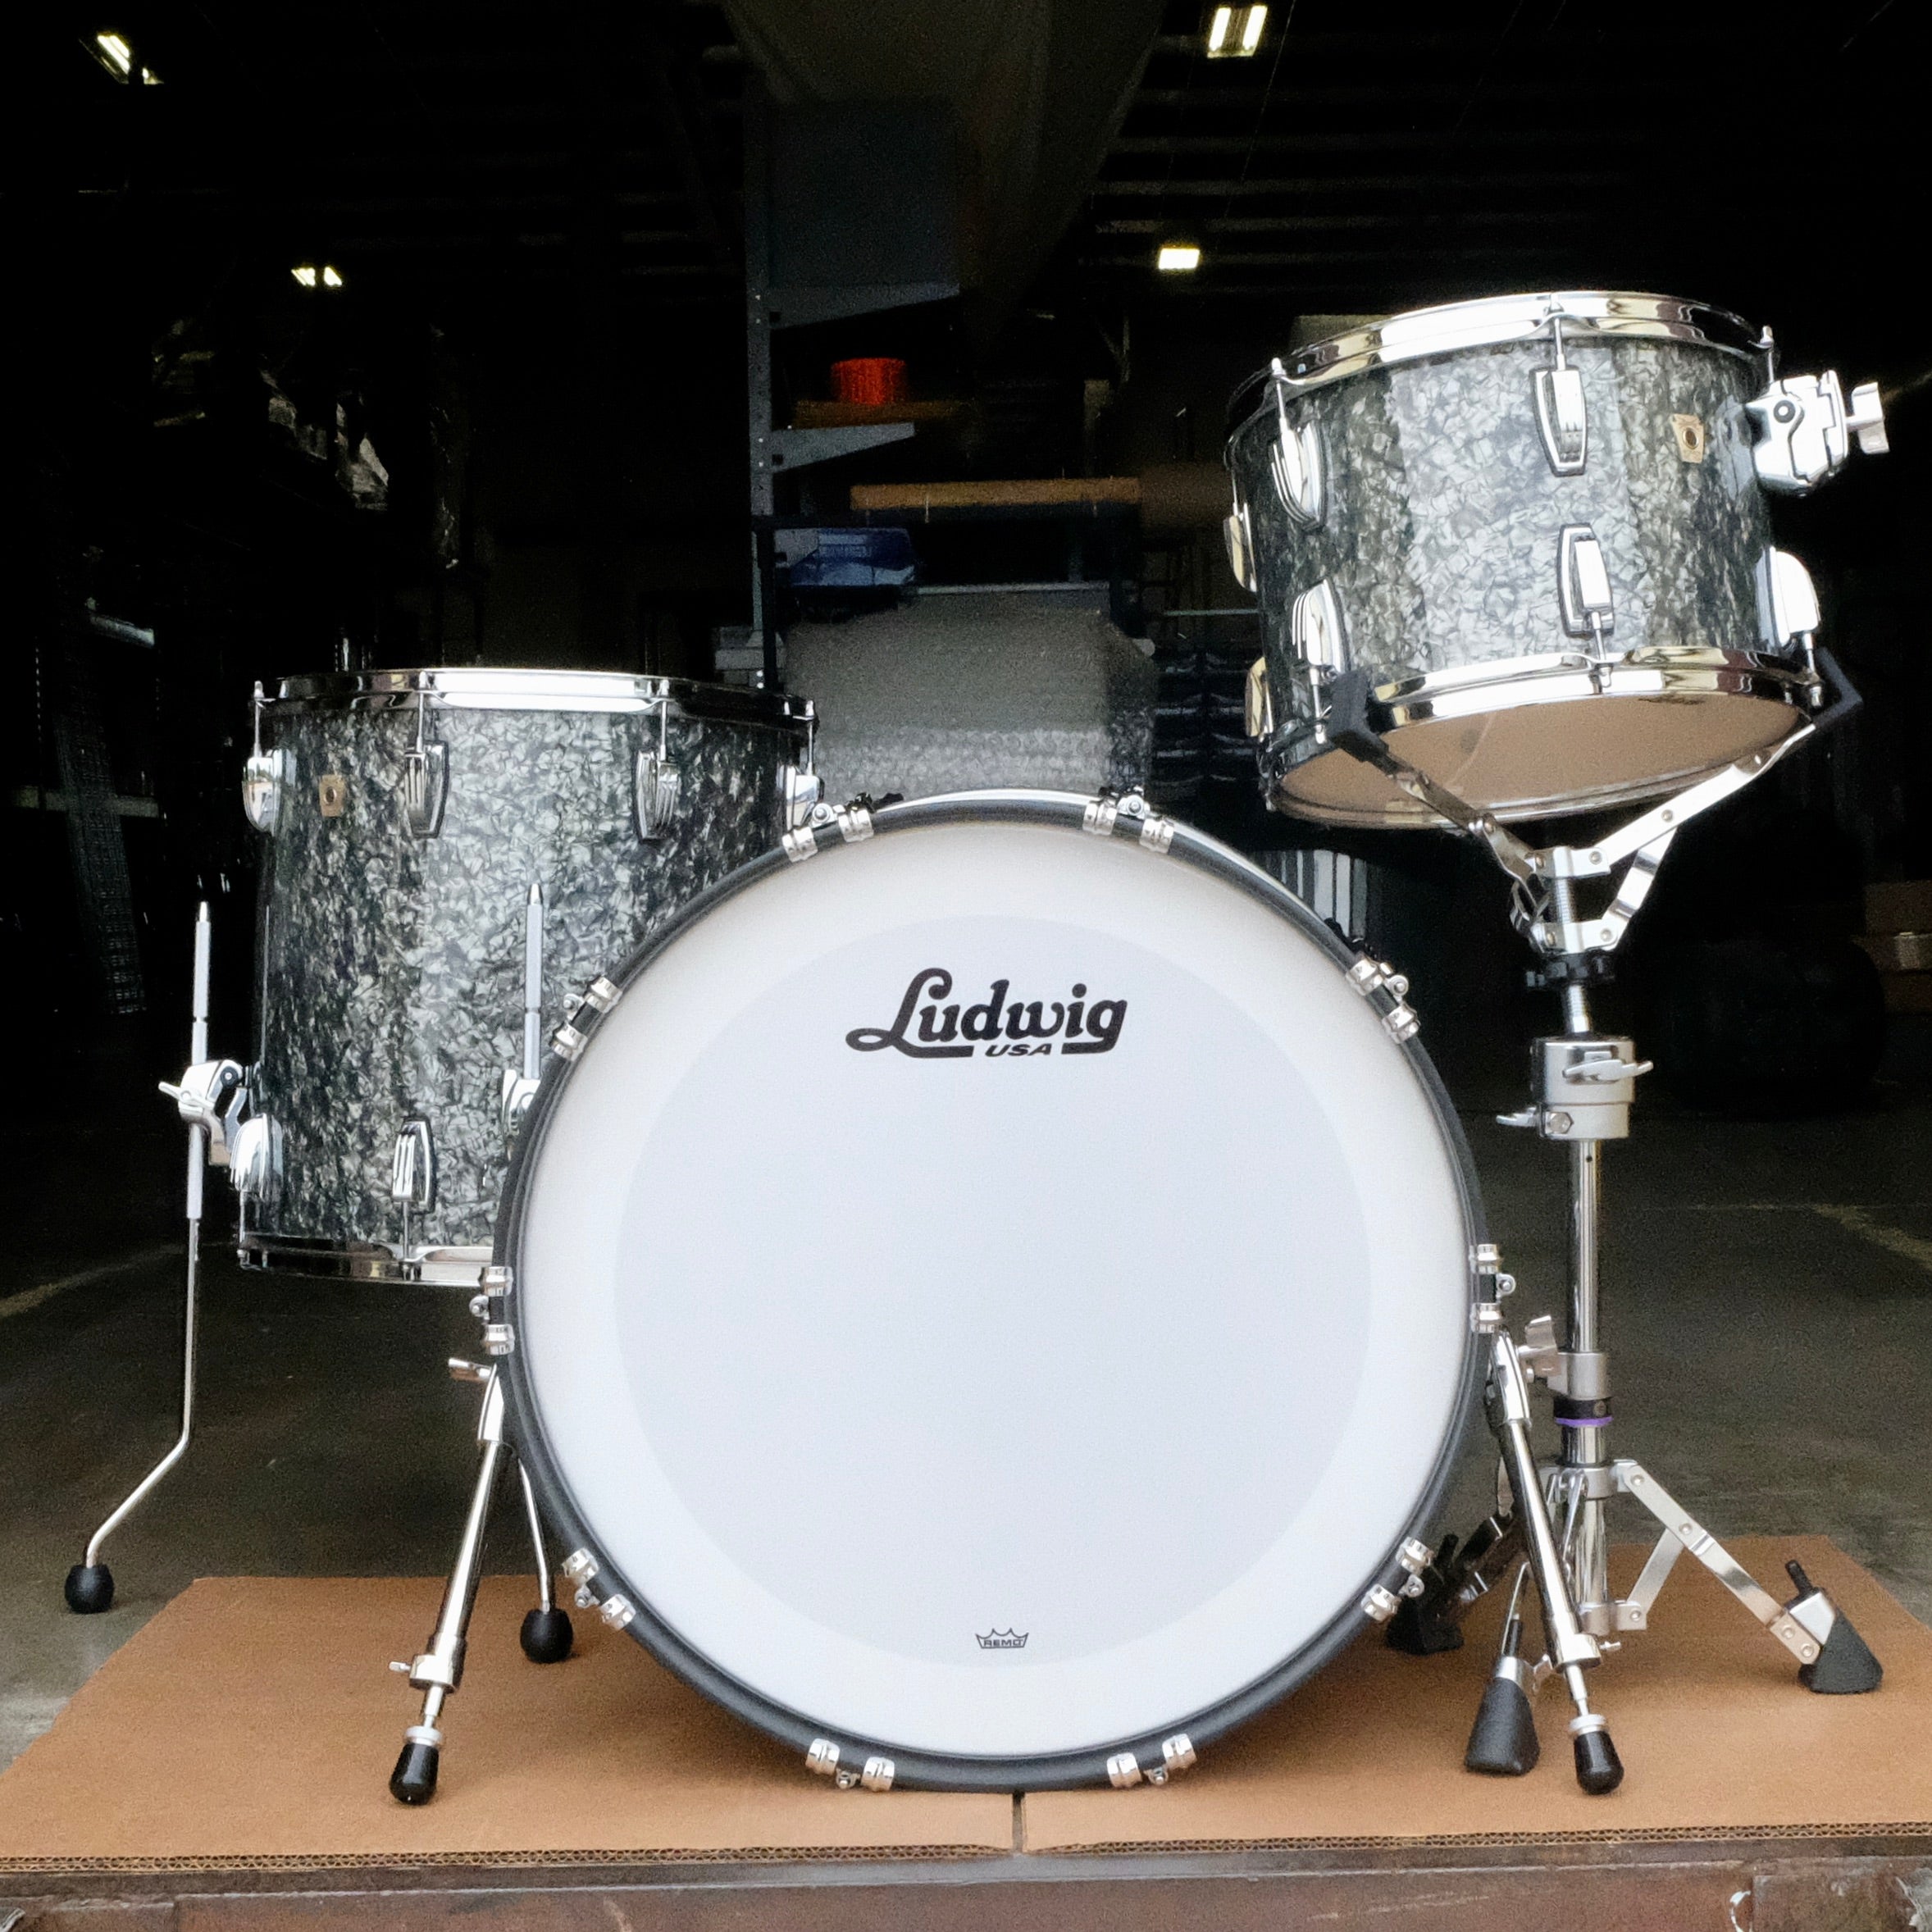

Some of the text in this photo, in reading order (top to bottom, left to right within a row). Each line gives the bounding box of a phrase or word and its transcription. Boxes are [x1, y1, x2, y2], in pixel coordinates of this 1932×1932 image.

[845, 968, 1128, 1059] Ludwig
[985, 1043, 1052, 1057] USA
[983, 1638, 1023, 1647] REMO
